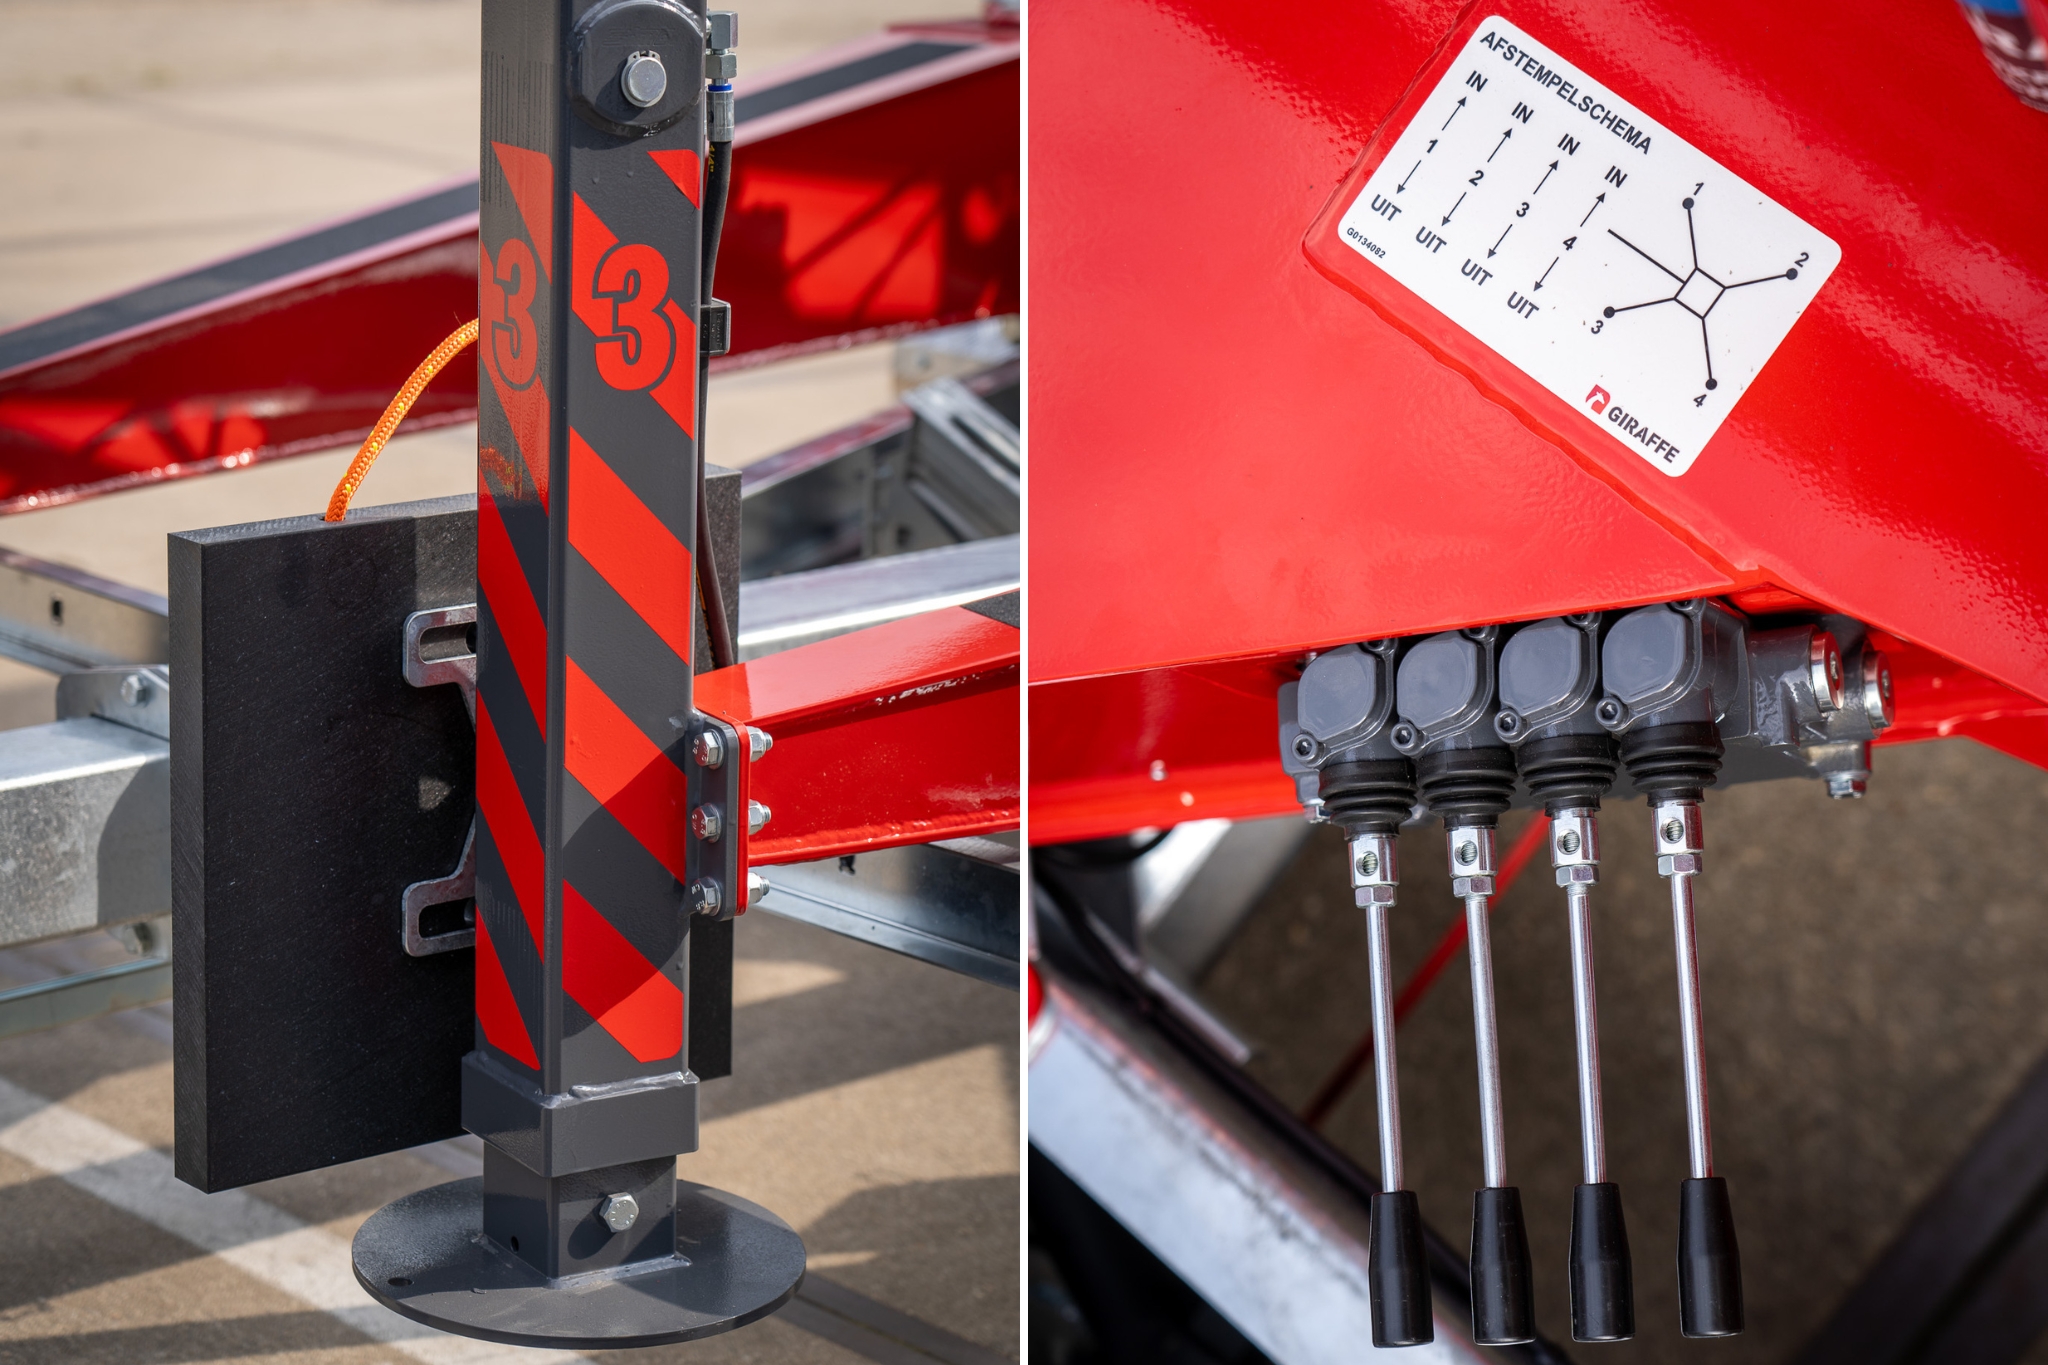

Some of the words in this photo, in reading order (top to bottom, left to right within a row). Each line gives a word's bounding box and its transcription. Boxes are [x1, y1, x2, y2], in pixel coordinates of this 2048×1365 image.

[1465, 70, 1489, 93] IN
[1479, 31, 1652, 155] AFSTEMPELSCHEMA
[1511, 101, 1535, 125] IN
[1426, 139, 1439, 154] 1
[1557, 133, 1581, 156] IN
[1468, 169, 1485, 187] 2
[1604, 165, 1628, 189] IN
[1693, 182, 1705, 196] 1
[1371, 193, 1402, 222] UIT
[1515, 201, 1530, 218] 3
[1346, 227, 1386, 259] G0134082
[1415, 226, 1448, 254] UIT
[1562, 236, 1578, 251] 4
[1794, 251, 1810, 268] 2
[1461, 258, 1493, 286] UIT
[492, 238, 539, 391] 3
[592, 243, 676, 390] 3
[1507, 291, 1540, 319] UIT
[1590, 319, 1604, 335] 3
[1693, 394, 1707, 408] 4
[1608, 406, 1680, 464] GIRAFFE
